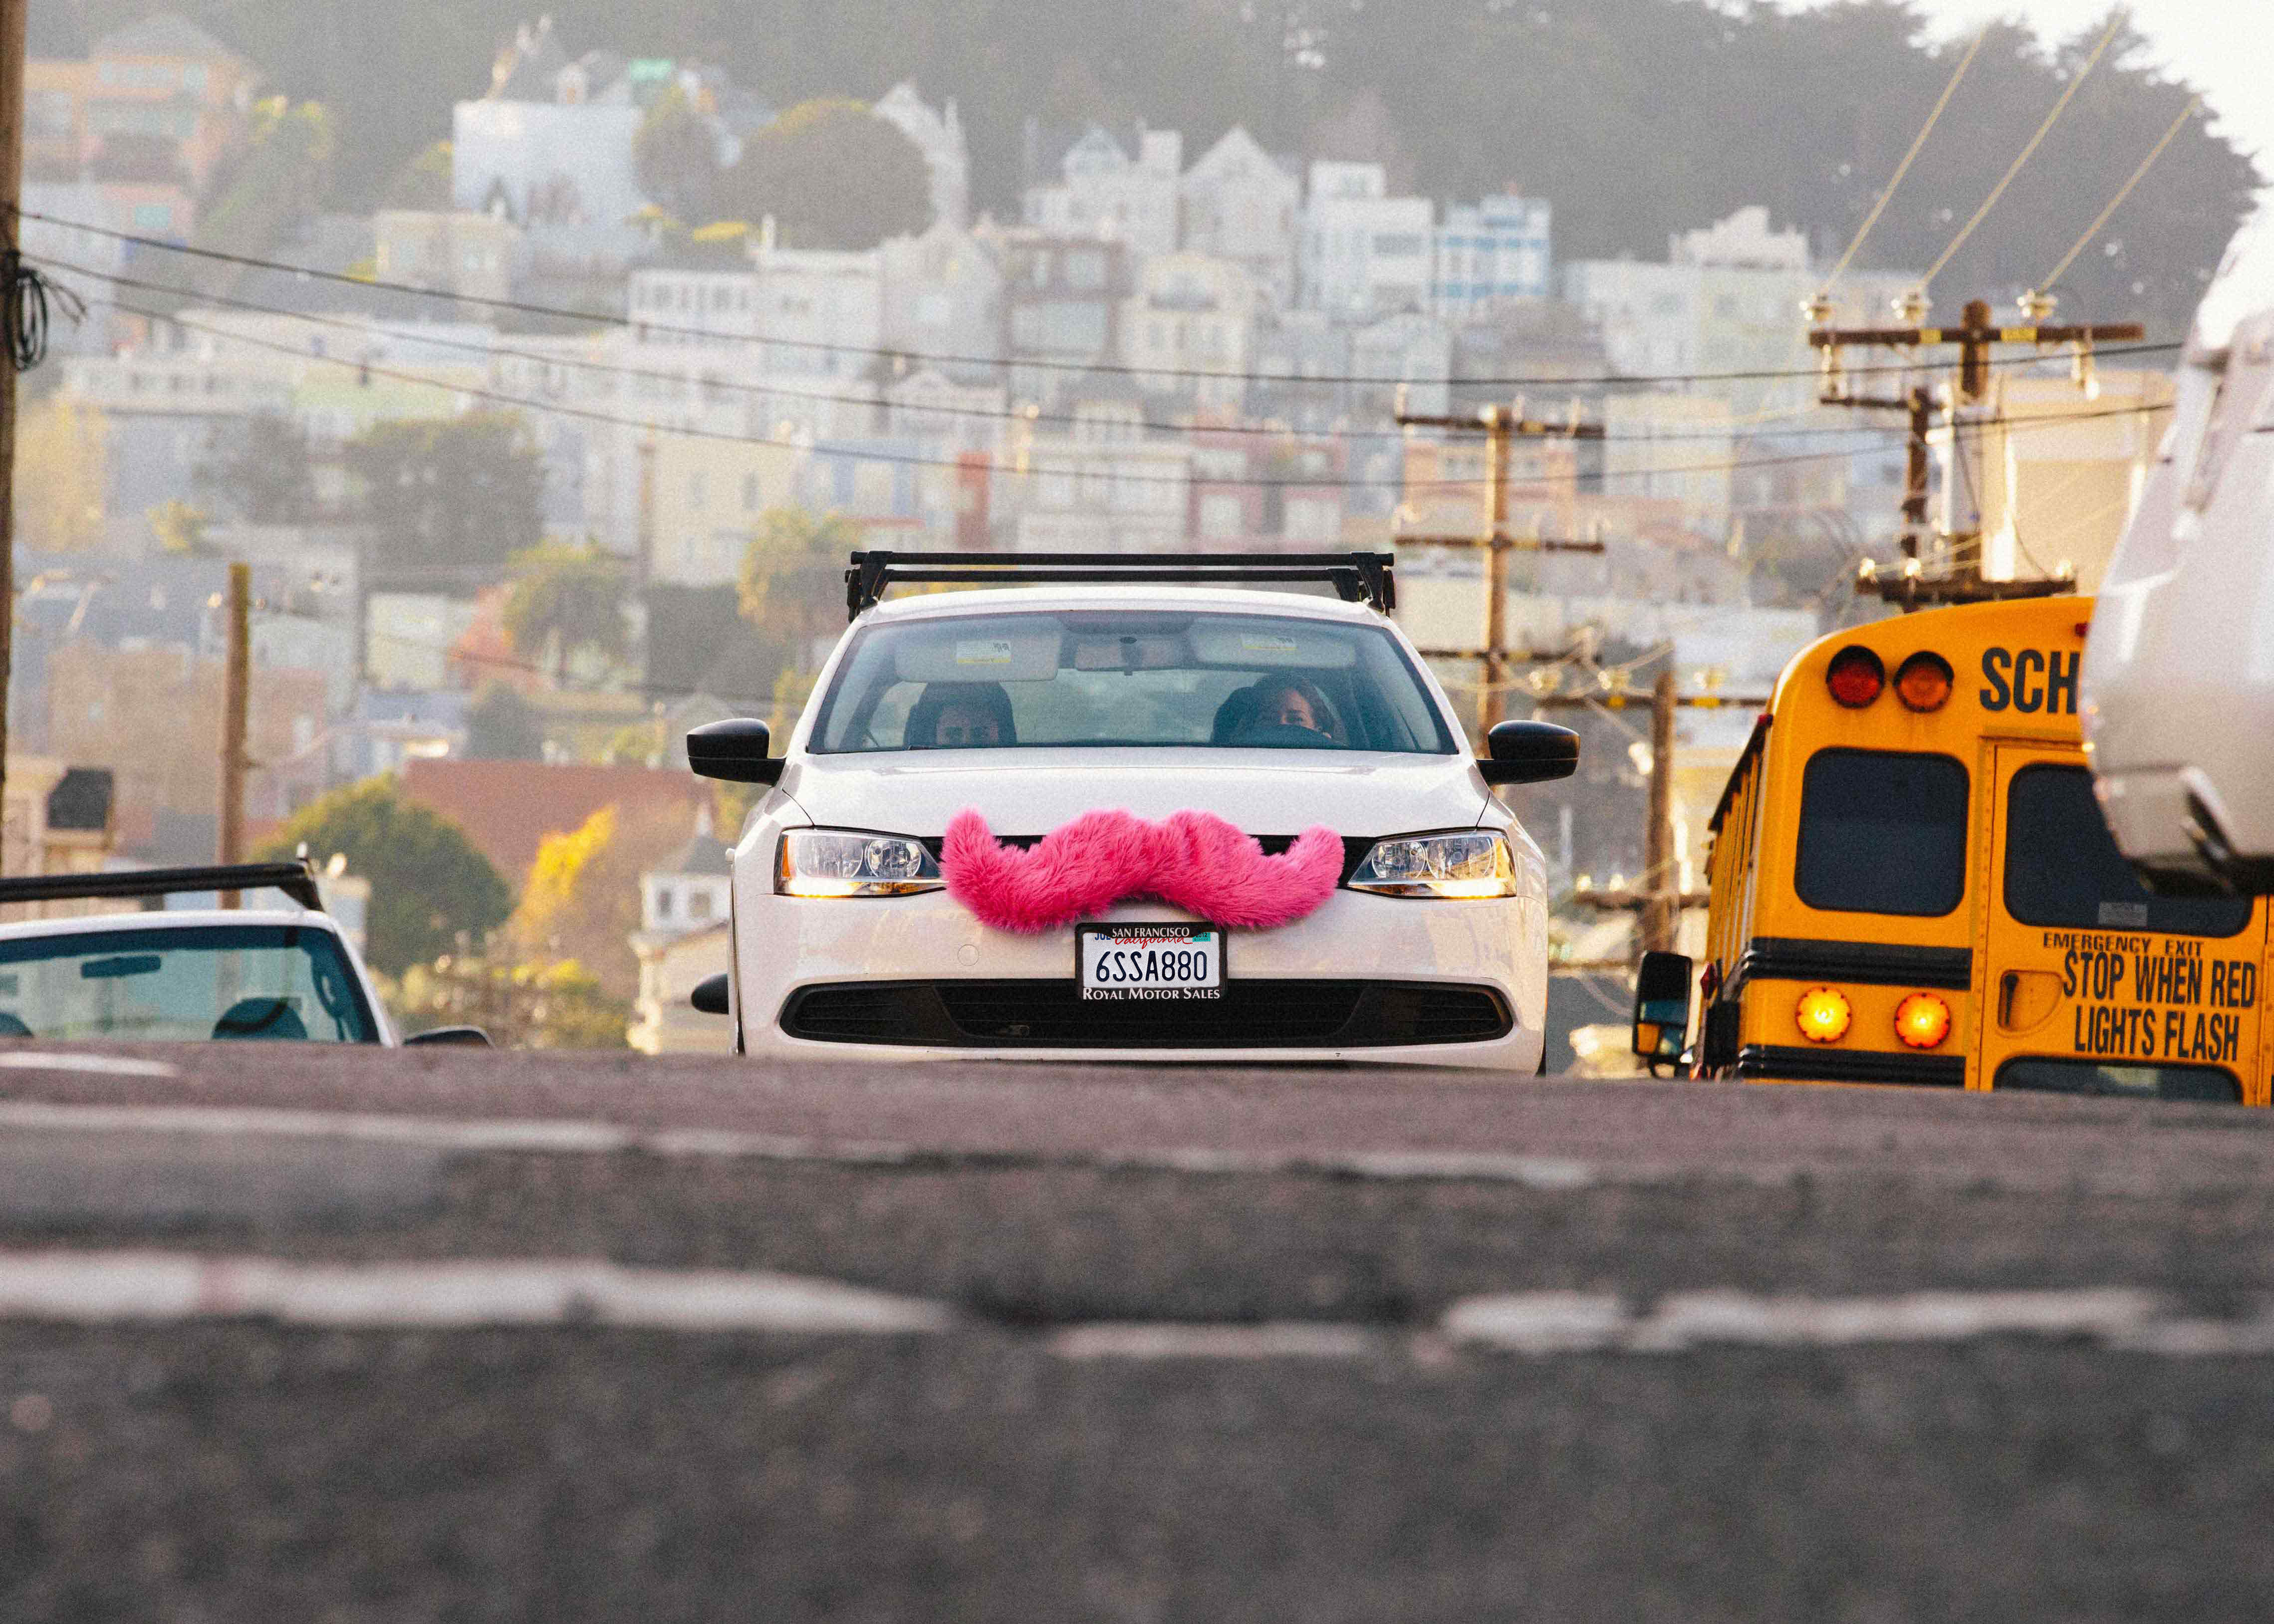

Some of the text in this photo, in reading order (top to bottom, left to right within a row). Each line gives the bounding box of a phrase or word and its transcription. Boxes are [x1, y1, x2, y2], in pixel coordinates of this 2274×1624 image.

[1112, 927, 1190, 937] SAN FRANCISCO
[2043, 932, 2204, 956] EMERGENCY EXIT
[1096, 950, 1207, 982] 6SSA880
[2063, 950, 2256, 1008] STOP WHEN RED
[1083, 987, 1220, 1000] ROYAL MOTOR SALES
[2074, 1005, 2240, 1062] LIGHTS FLASH
